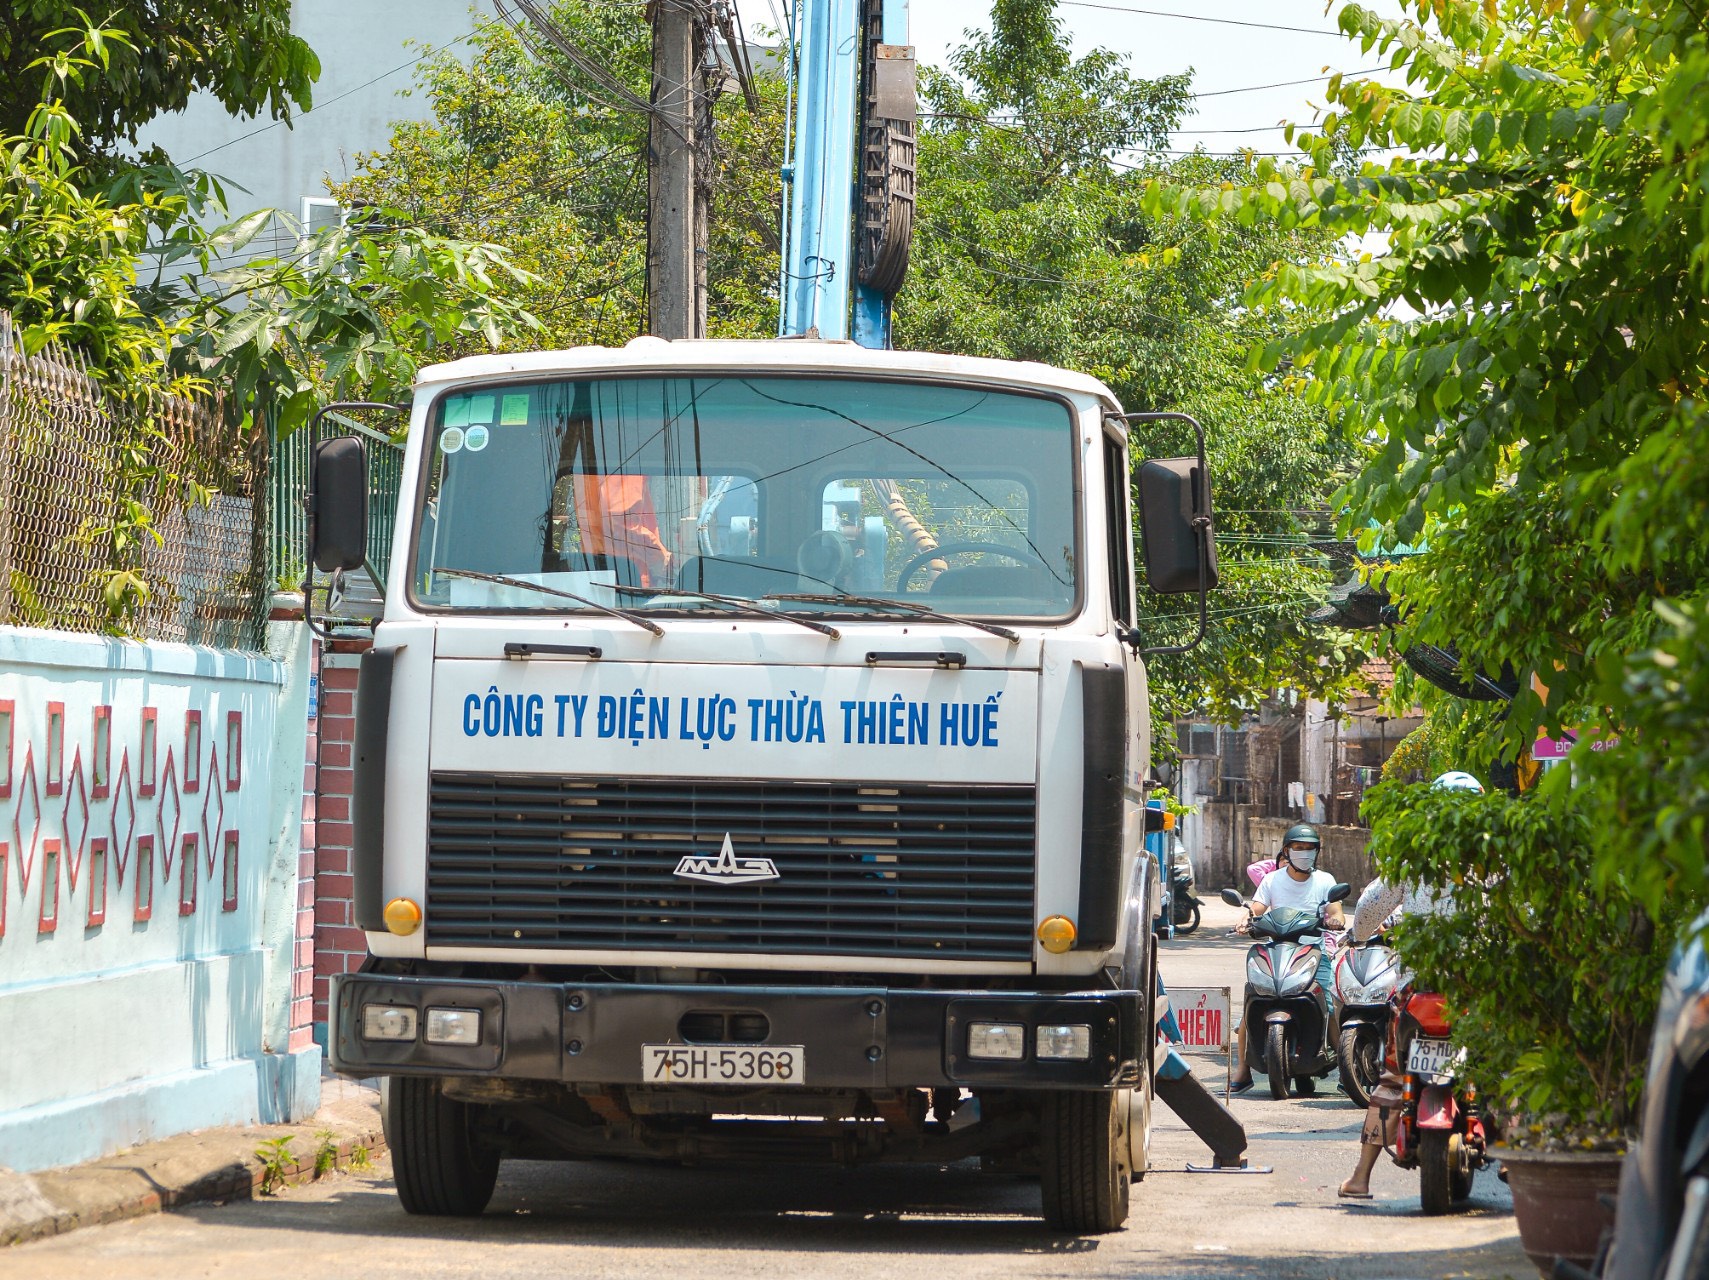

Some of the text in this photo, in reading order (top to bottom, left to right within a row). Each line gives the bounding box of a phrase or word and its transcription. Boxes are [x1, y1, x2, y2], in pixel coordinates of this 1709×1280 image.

[463, 686, 1003, 750] CÔNG TY ĐIỆN LỰC THỪA THIÊN HUẾ
[1178, 993, 1221, 1046] HIỂM
[653, 1049, 793, 1079] 75H-5363
